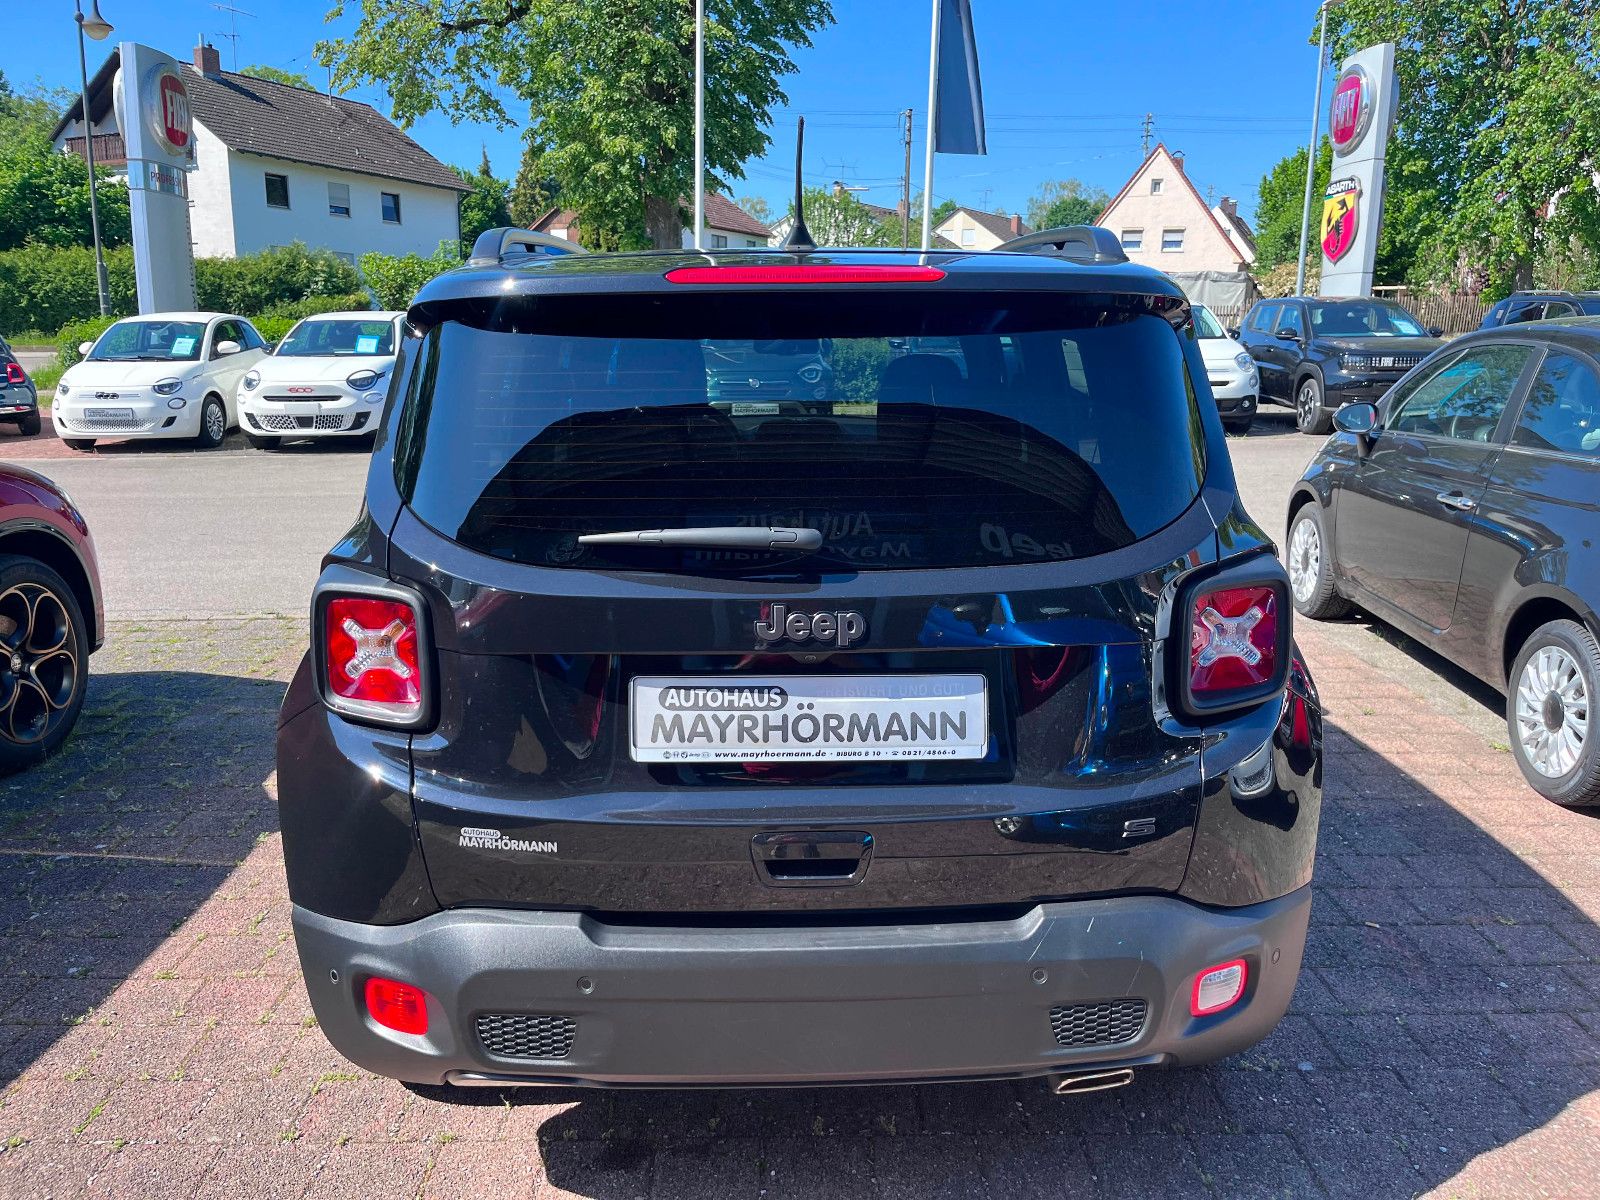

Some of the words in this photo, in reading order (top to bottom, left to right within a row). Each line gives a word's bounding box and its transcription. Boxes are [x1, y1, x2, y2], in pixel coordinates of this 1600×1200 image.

[1332, 87, 1359, 131] FIAT
[1325, 179, 1356, 197] ABARTH
[755, 603, 866, 647] Jeep
[665, 687, 782, 707] AUTOHAUS
[650, 702, 967, 743] MAYRHÖRMANN
[714, 750, 827, 760] www.mayrhoermann.de
[902, 749, 956, 757] 0821/4866-0
[462, 828, 499, 838] AUTOHAUS
[1121, 817, 1156, 838] S
[459, 835, 558, 853] MAYRHÖRMANN
